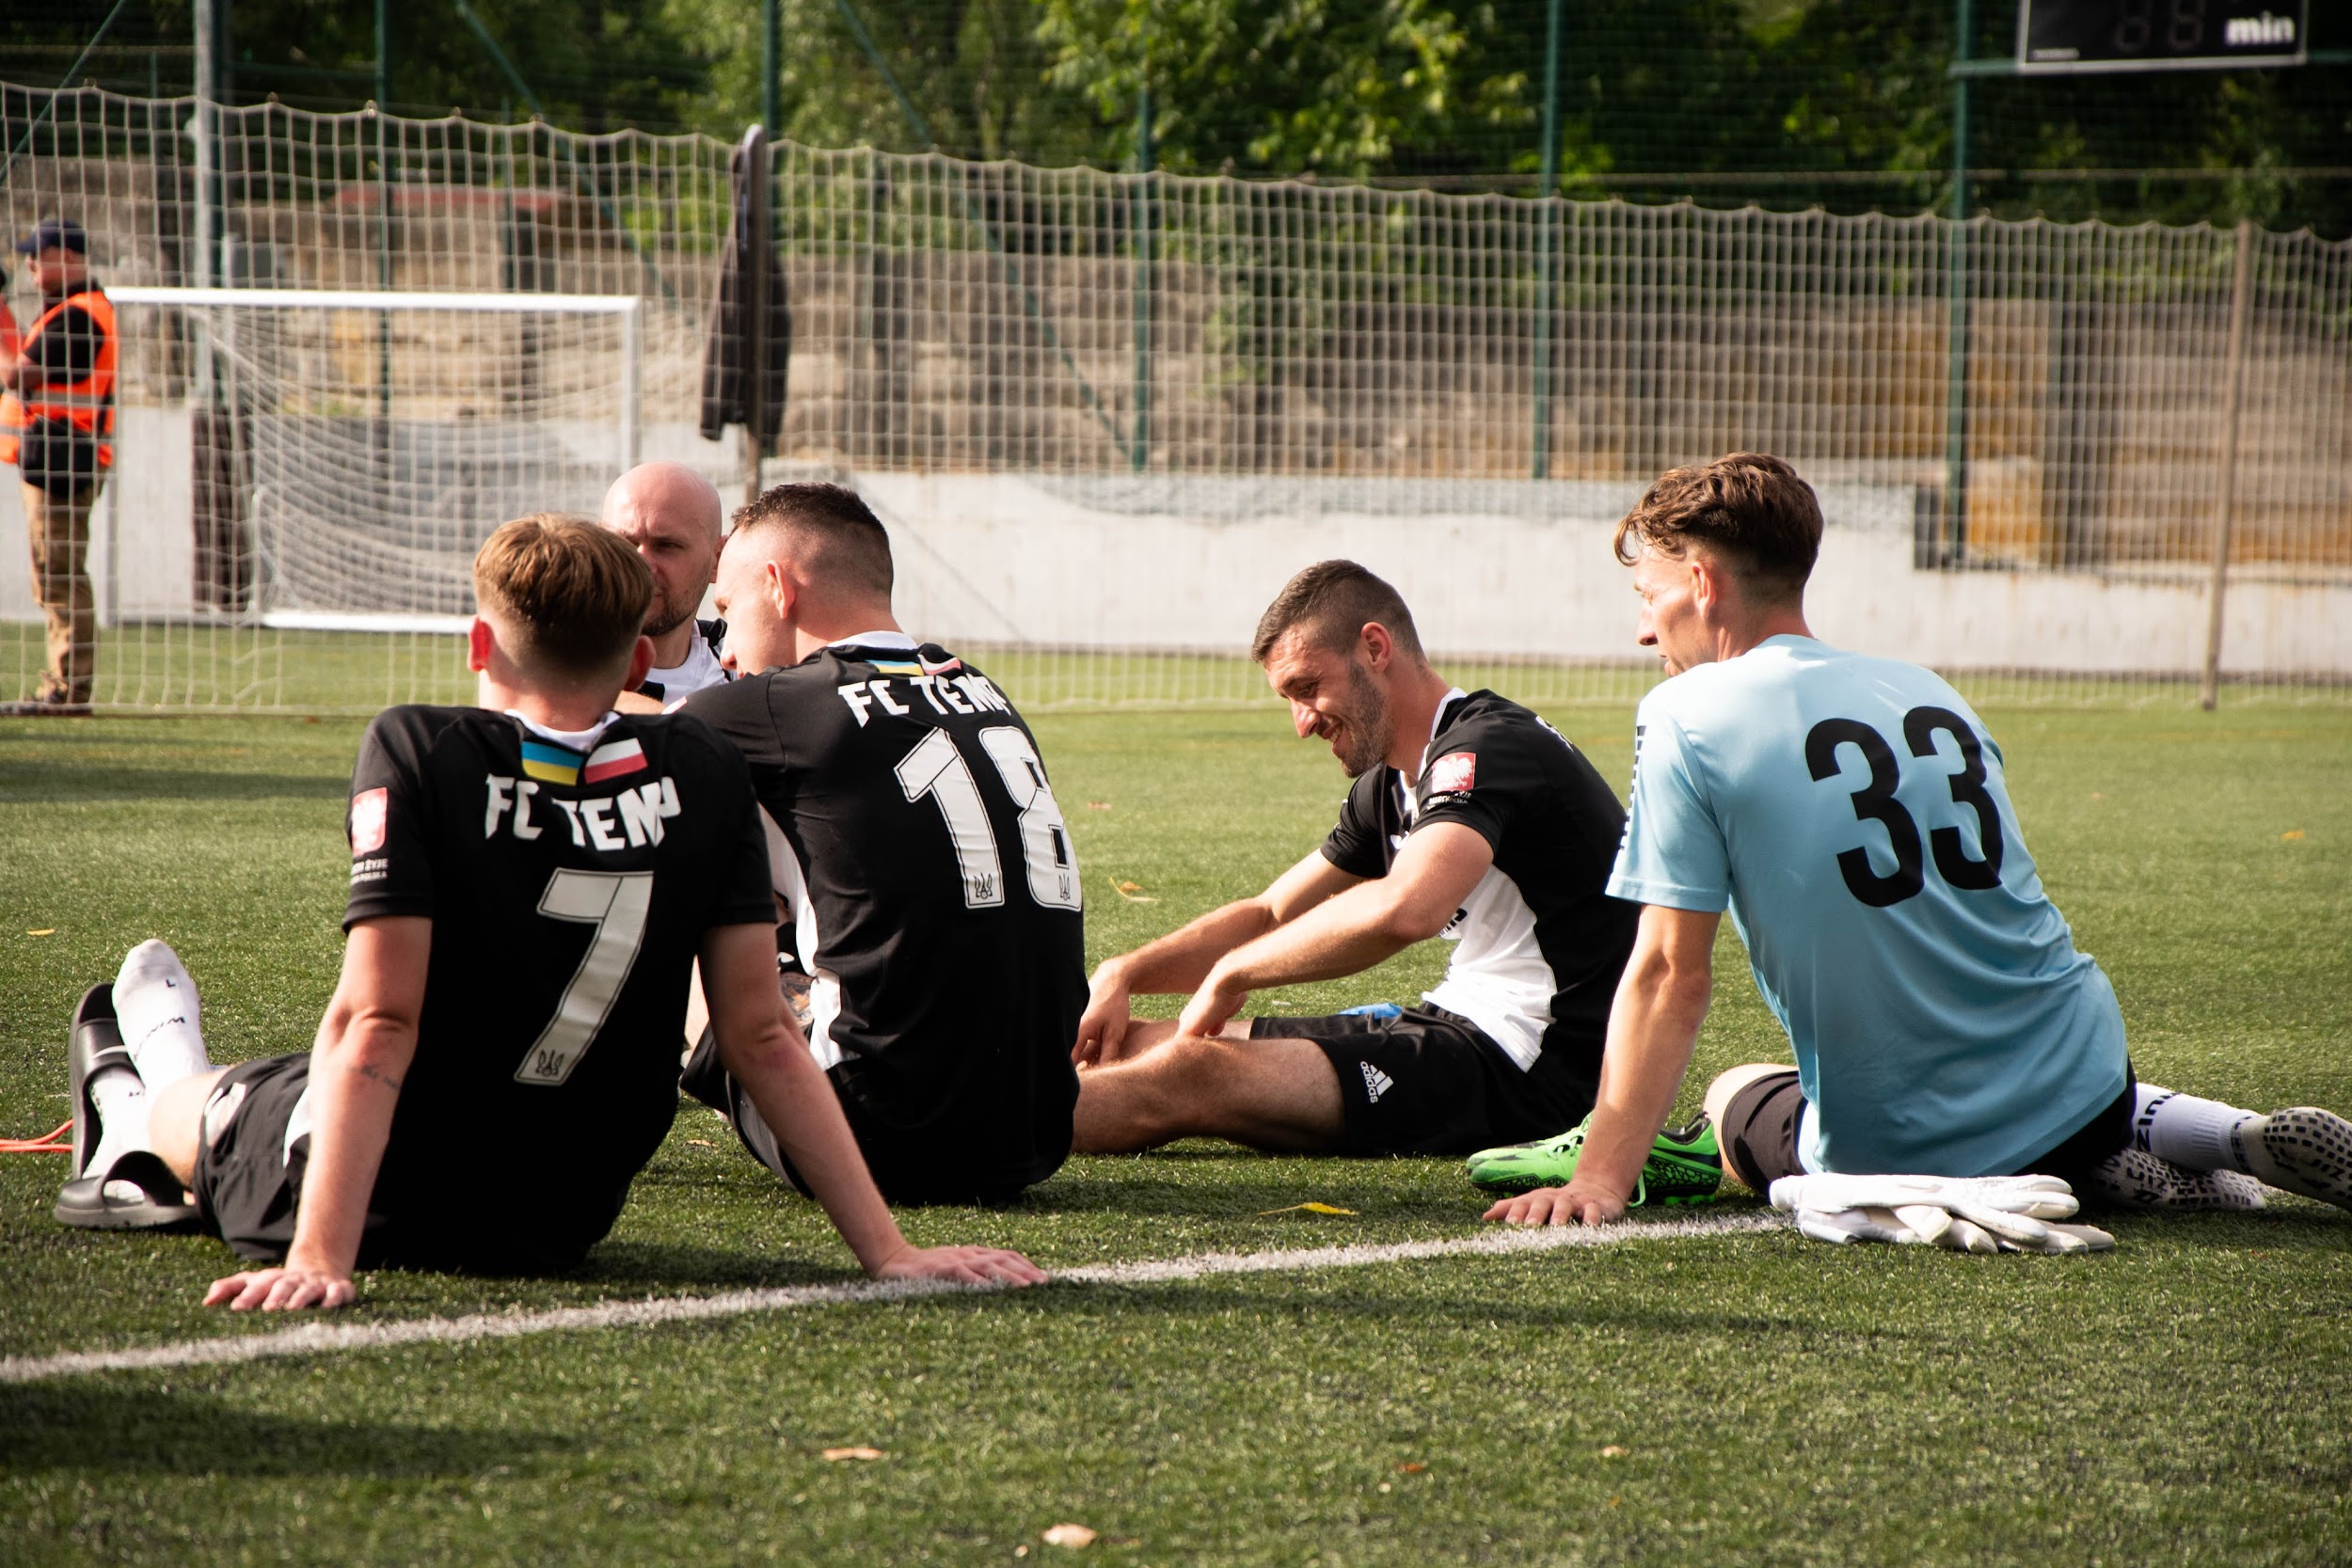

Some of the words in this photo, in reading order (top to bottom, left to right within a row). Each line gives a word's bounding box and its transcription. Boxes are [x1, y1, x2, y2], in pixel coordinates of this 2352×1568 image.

[2225, 10, 2296, 46] min
[838, 679, 910, 728] FC
[485, 772, 543, 840] FC
[893, 725, 1083, 912] 18
[1804, 705, 2004, 908] 33
[514, 867, 654, 1086] 7
[1360, 1061, 1378, 1103] adidas
